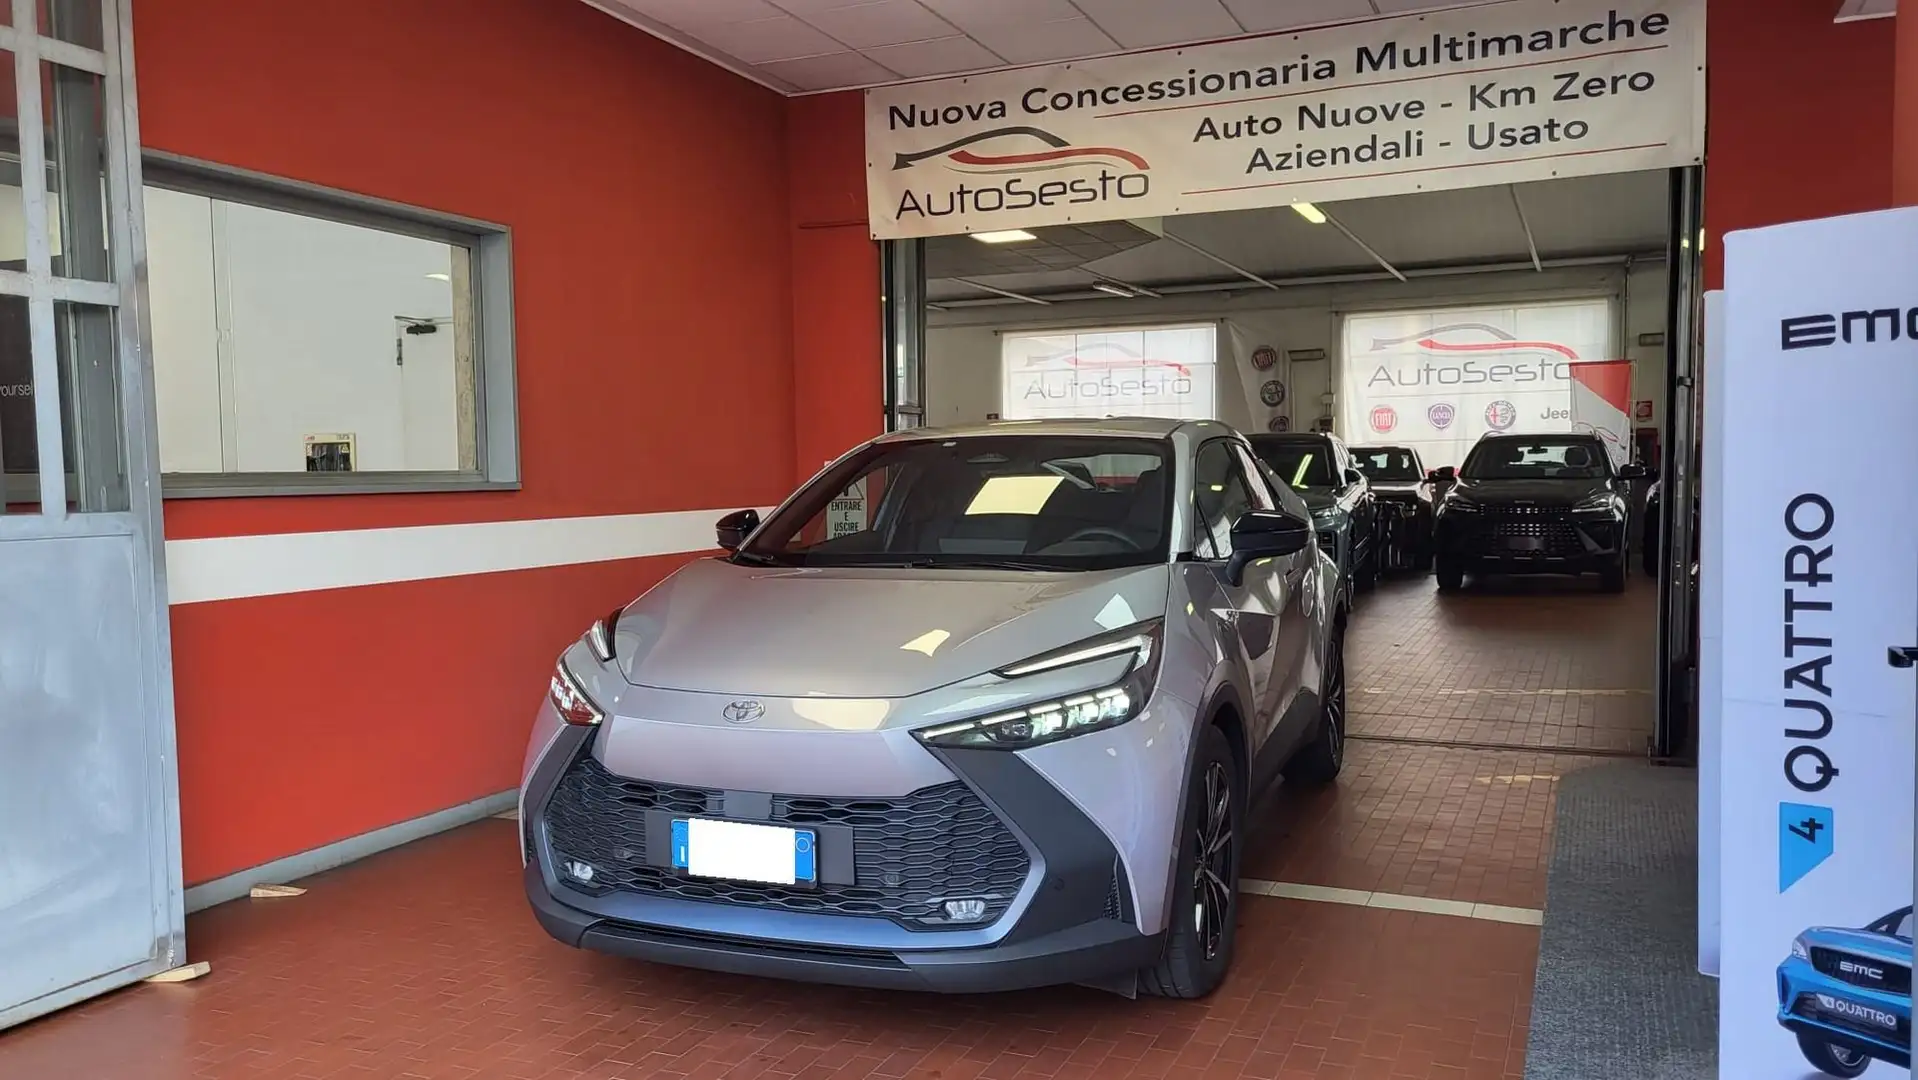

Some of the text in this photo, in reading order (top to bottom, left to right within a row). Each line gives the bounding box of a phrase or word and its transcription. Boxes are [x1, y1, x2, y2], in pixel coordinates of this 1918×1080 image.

[889, 10, 1670, 130] Nuova Concessionaria Multimarche
[1193, 115, 1282, 142] Auto
[1298, 99, 1425, 131] Nuove
[1469, 82, 1536, 111] Km
[1553, 72, 1655, 101] Zero
[1245, 130, 1423, 174] Aziendali
[1468, 119, 1588, 150] Usato
[896, 169, 1149, 220] AutoSesto
[1781, 307, 1918, 350] EM
[0, 381, 33, 396] oursel
[1024, 373, 1191, 399] AutoSesto
[1540, 407, 1569, 419] Jee
[831, 501, 862, 511] ENTRARE
[845, 512, 849, 521] E
[834, 522, 859, 531] USCIRE
[1784, 493, 1839, 844] 4 QUATTRO
[1836, 1000, 1896, 1026] QUATTRO
